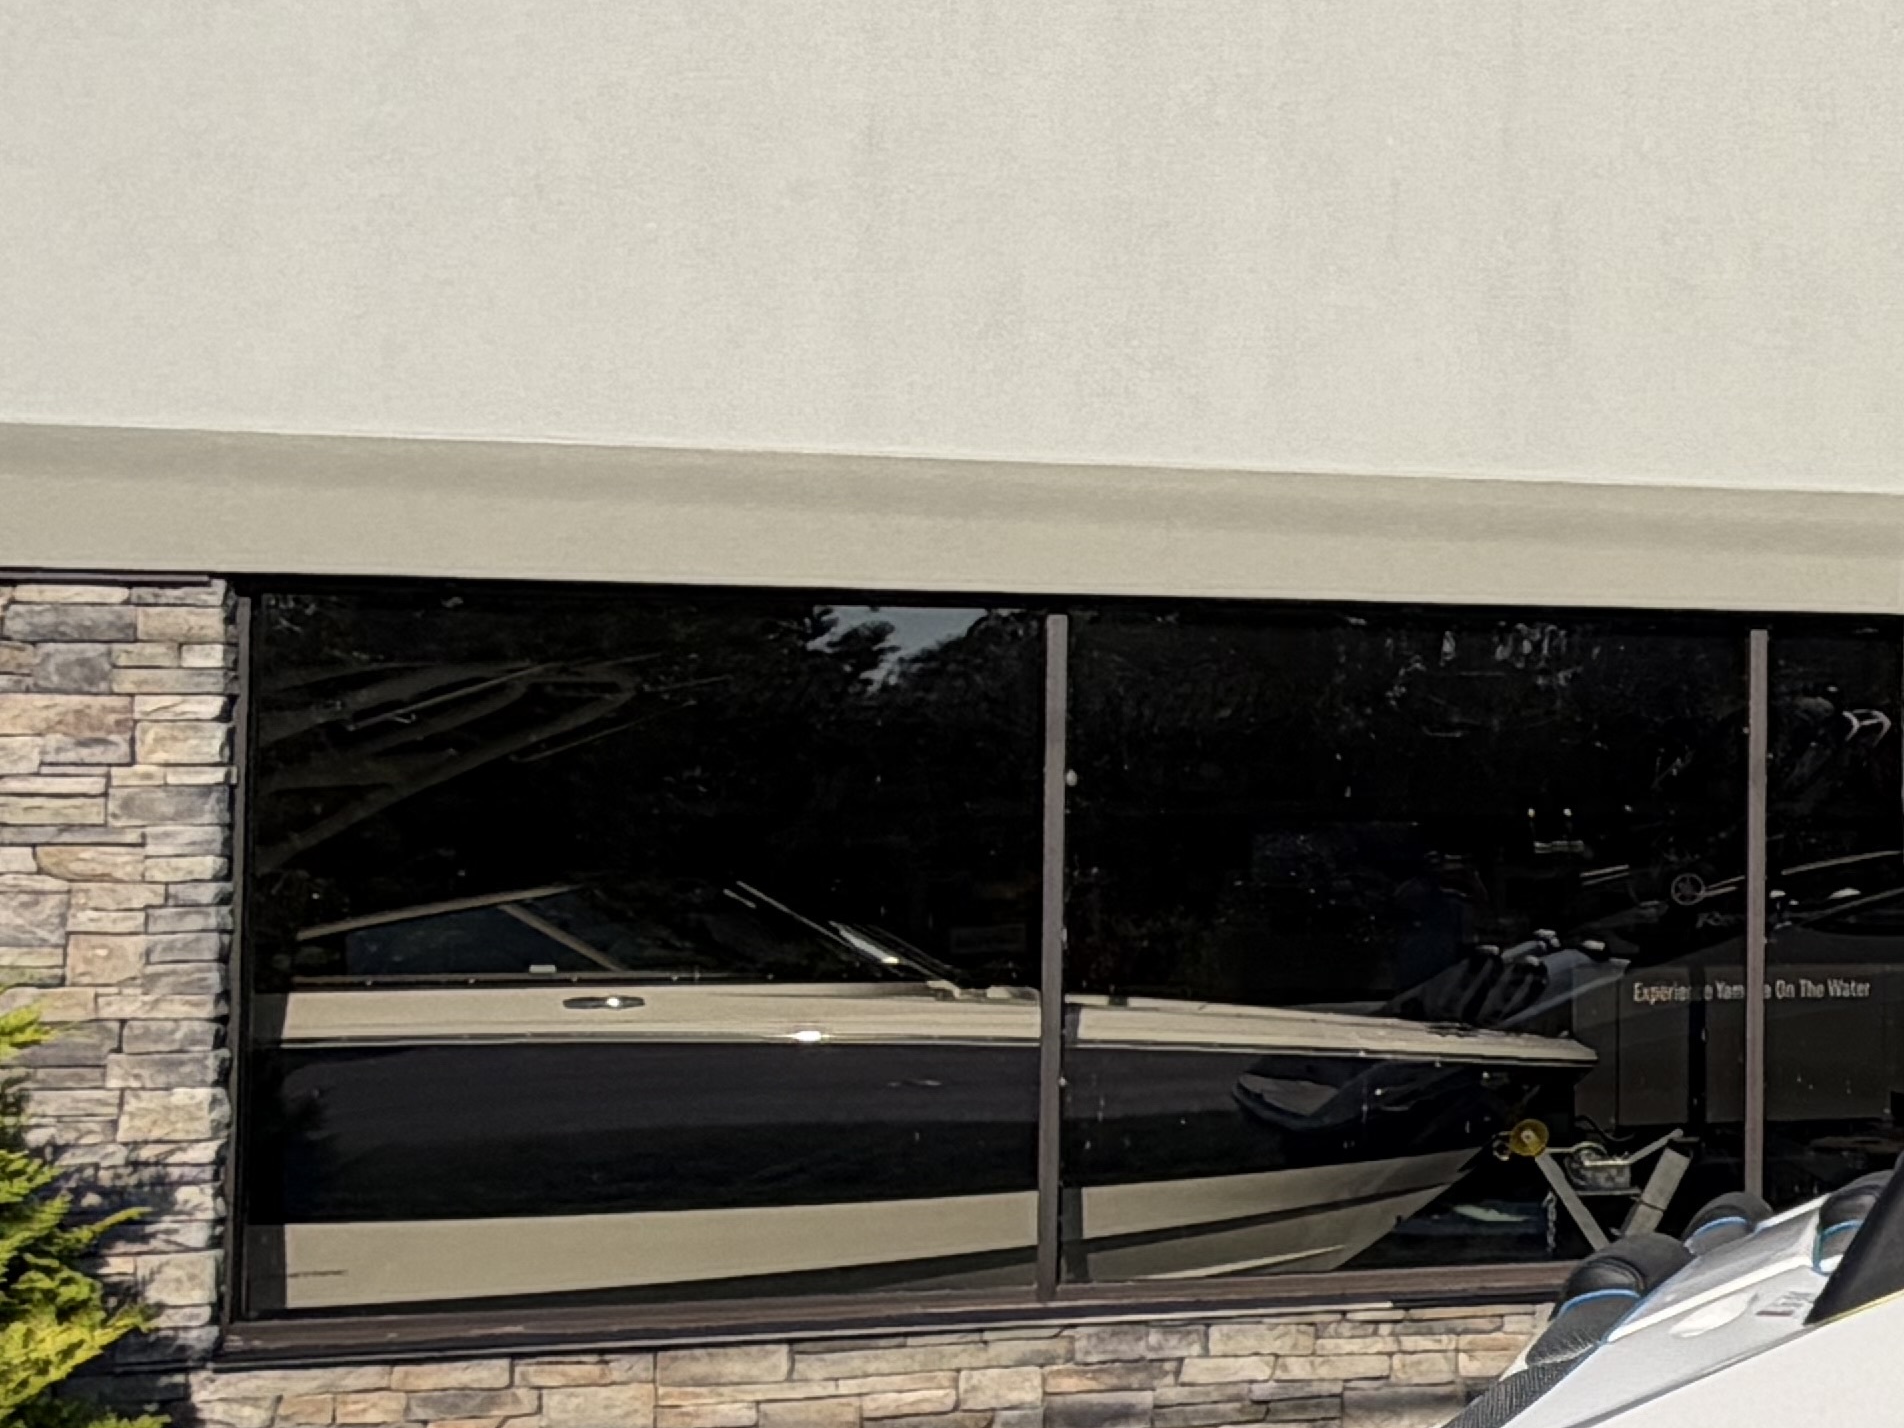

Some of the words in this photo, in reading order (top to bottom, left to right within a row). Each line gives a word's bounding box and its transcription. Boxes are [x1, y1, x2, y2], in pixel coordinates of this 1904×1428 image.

[1633, 980, 1713, 1006] Experiene
[1715, 979, 1772, 1000] Yama
[1775, 978, 1796, 1000] On
[1799, 978, 1825, 999] The
[1827, 977, 1871, 998] Water
